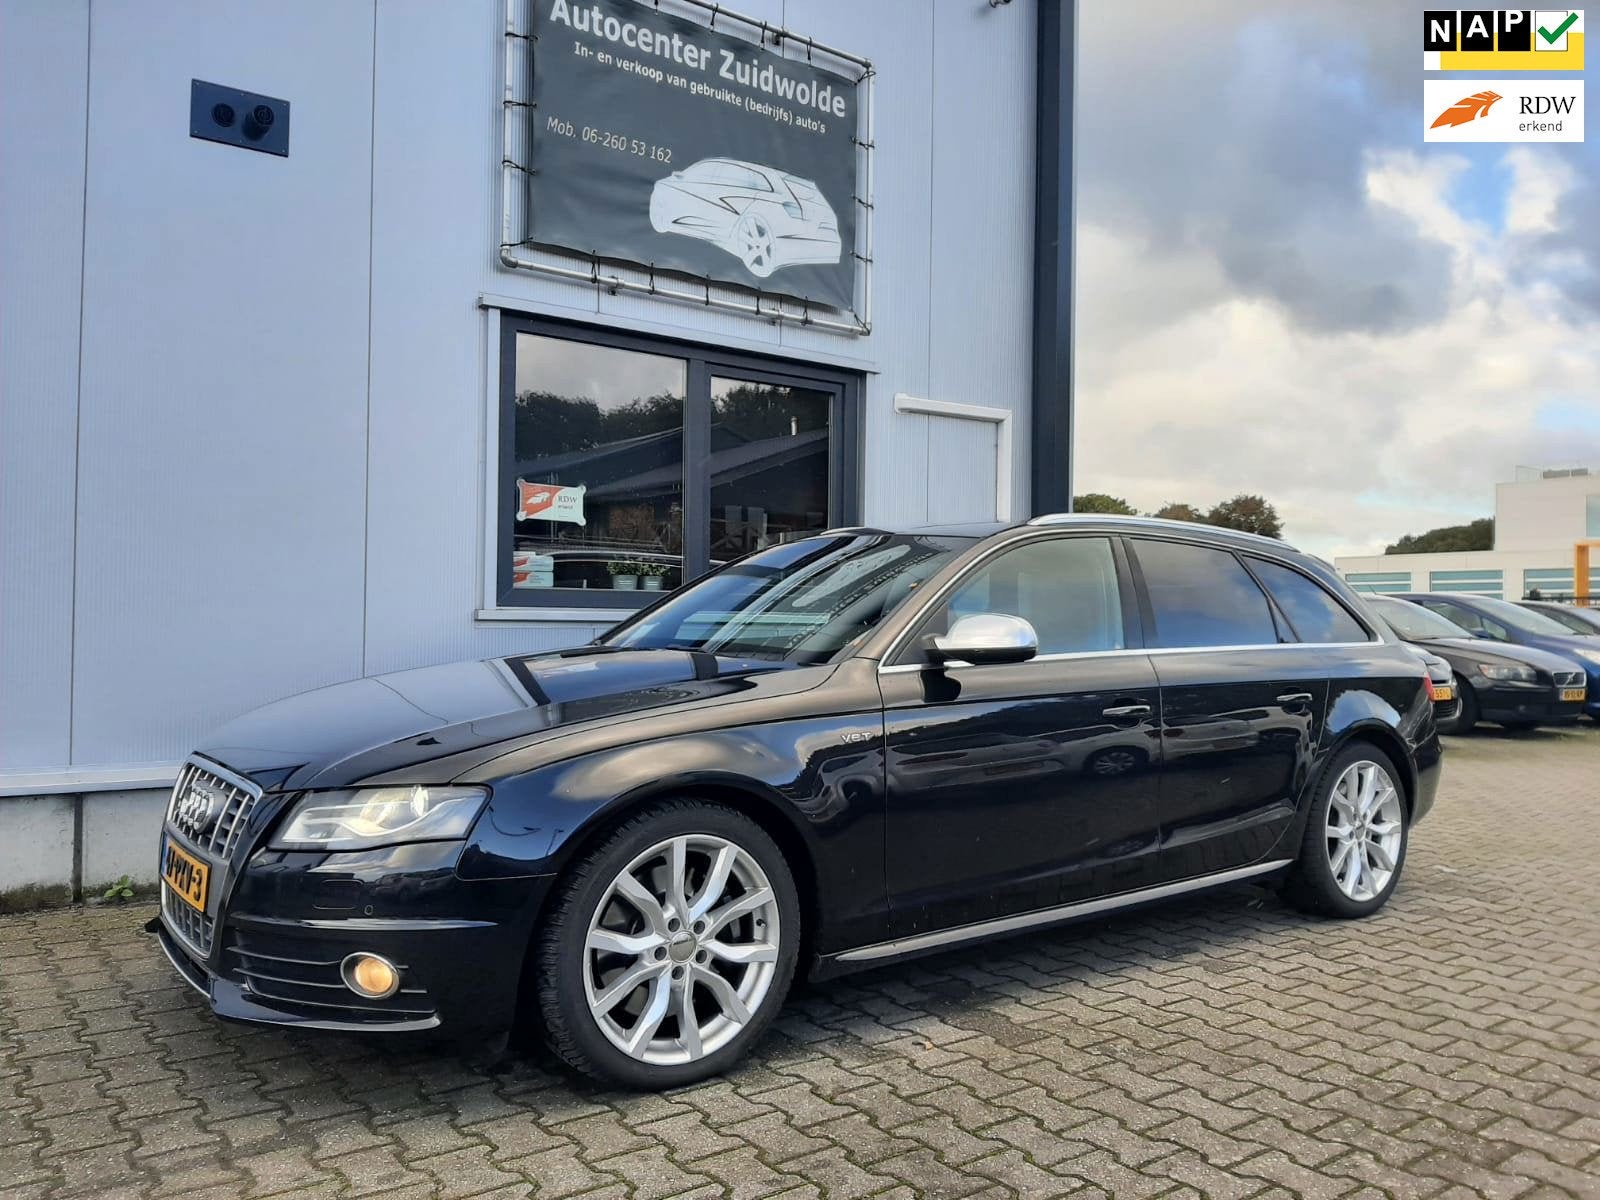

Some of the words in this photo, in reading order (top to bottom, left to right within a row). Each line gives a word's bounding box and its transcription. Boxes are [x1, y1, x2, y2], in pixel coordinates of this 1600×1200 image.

[549, 0, 711, 71] Autocenter
[719, 48, 846, 118] Zuidwolde
[597, 51, 612, 65] en
[616, 57, 663, 83] verkoop
[666, 74, 687, 89] van
[690, 80, 742, 107] gebruikte
[745, 96, 793, 125] (bedrijfs)
[796, 116, 826, 134] auto's
[546, 116, 577, 138] Mob.
[582, 126, 627, 152] 06-260
[631, 139, 646, 156] 53
[650, 145, 672, 164] 162
